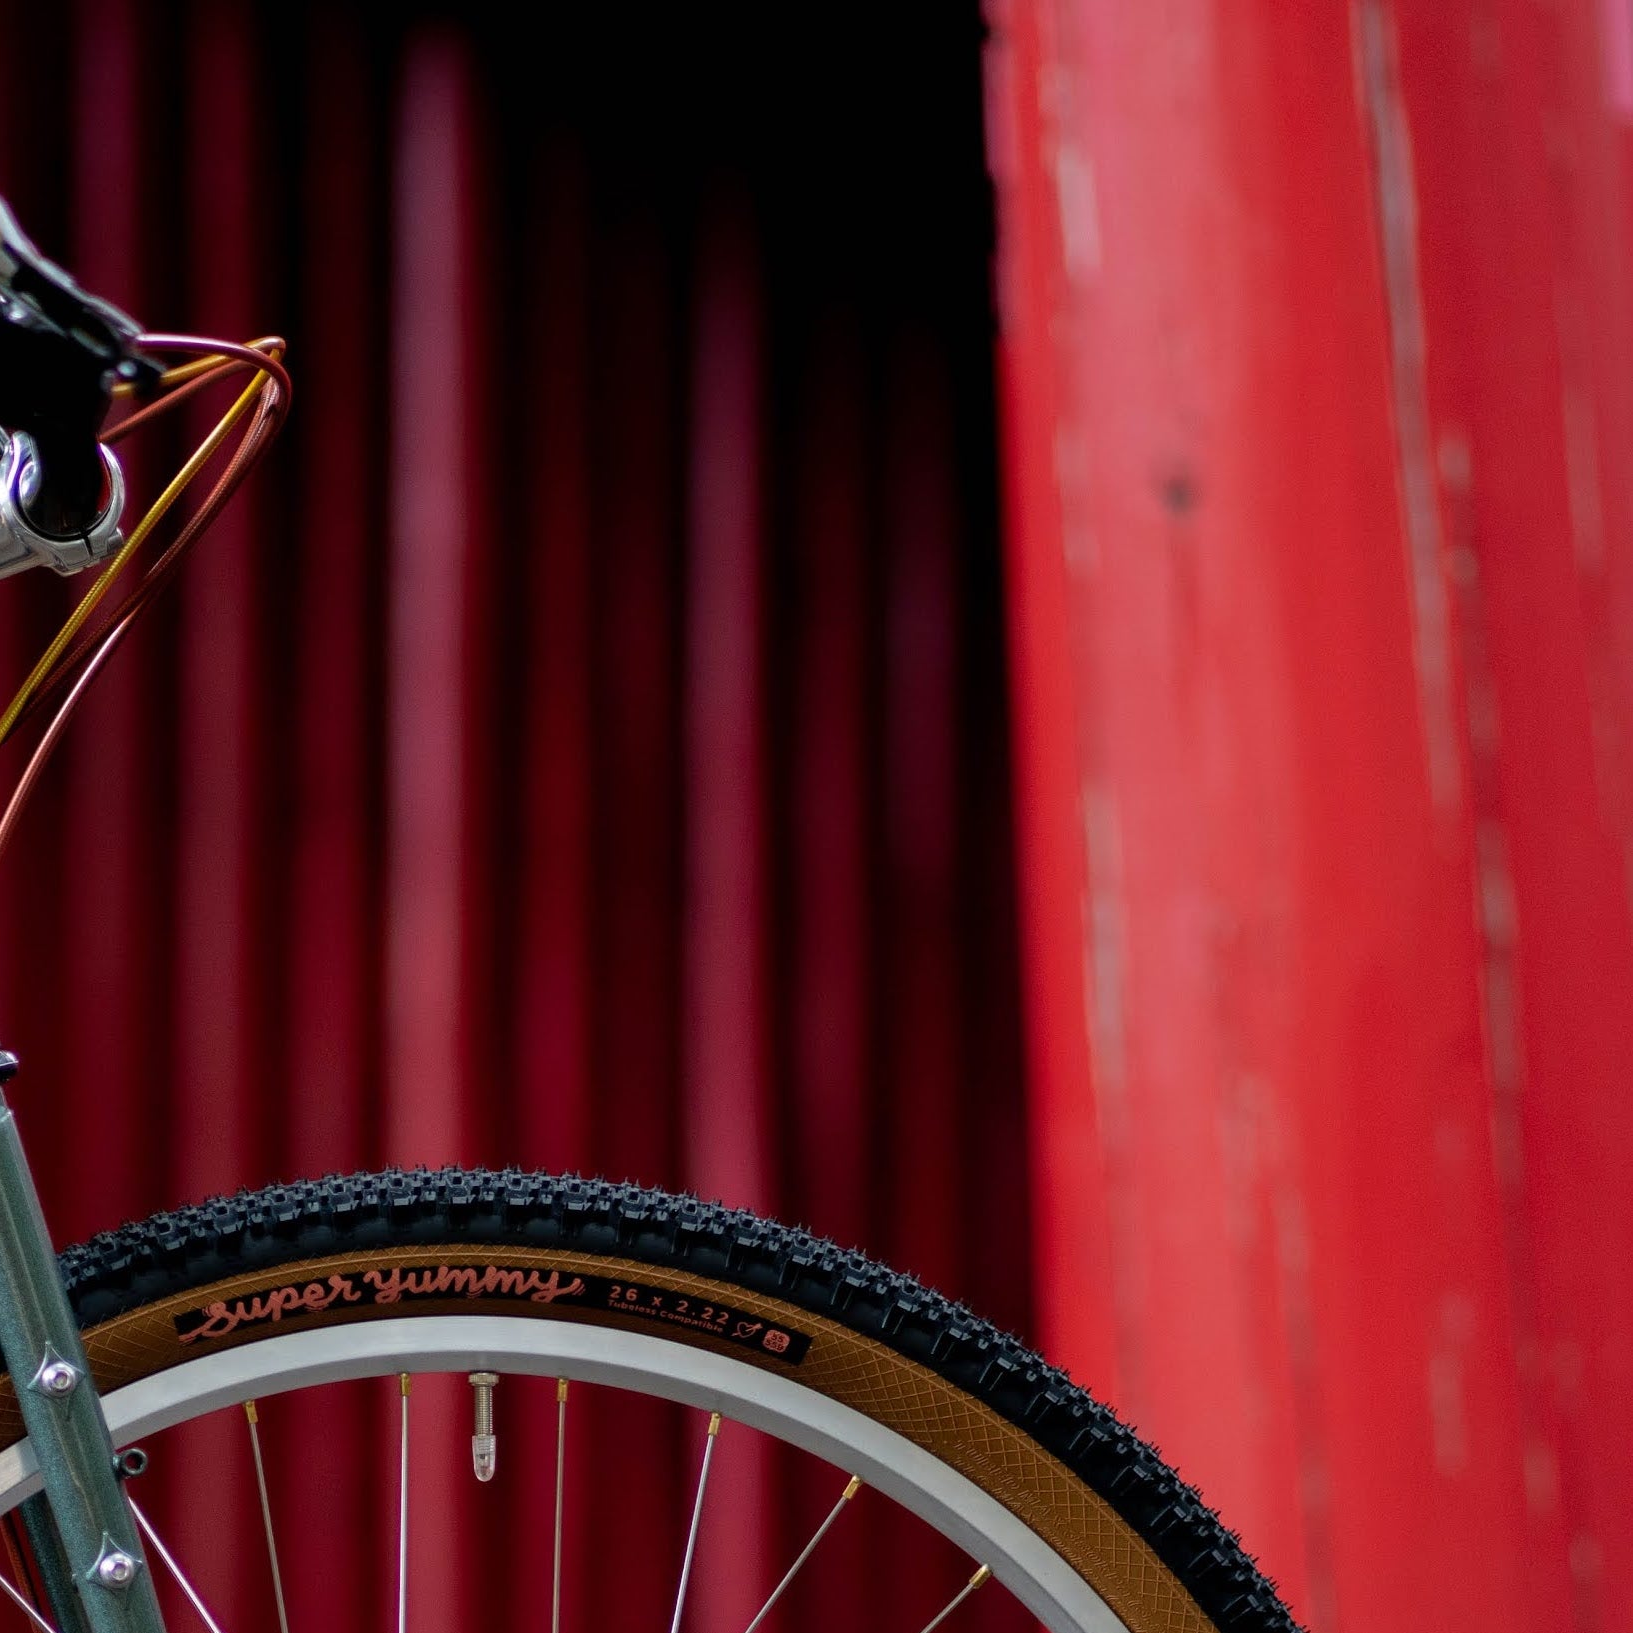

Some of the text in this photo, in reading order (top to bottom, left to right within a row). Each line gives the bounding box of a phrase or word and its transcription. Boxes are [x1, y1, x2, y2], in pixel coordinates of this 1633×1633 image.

[608, 1300, 657, 1316] Tubeless
[609, 1284, 729, 1325] 26 x 2.22
